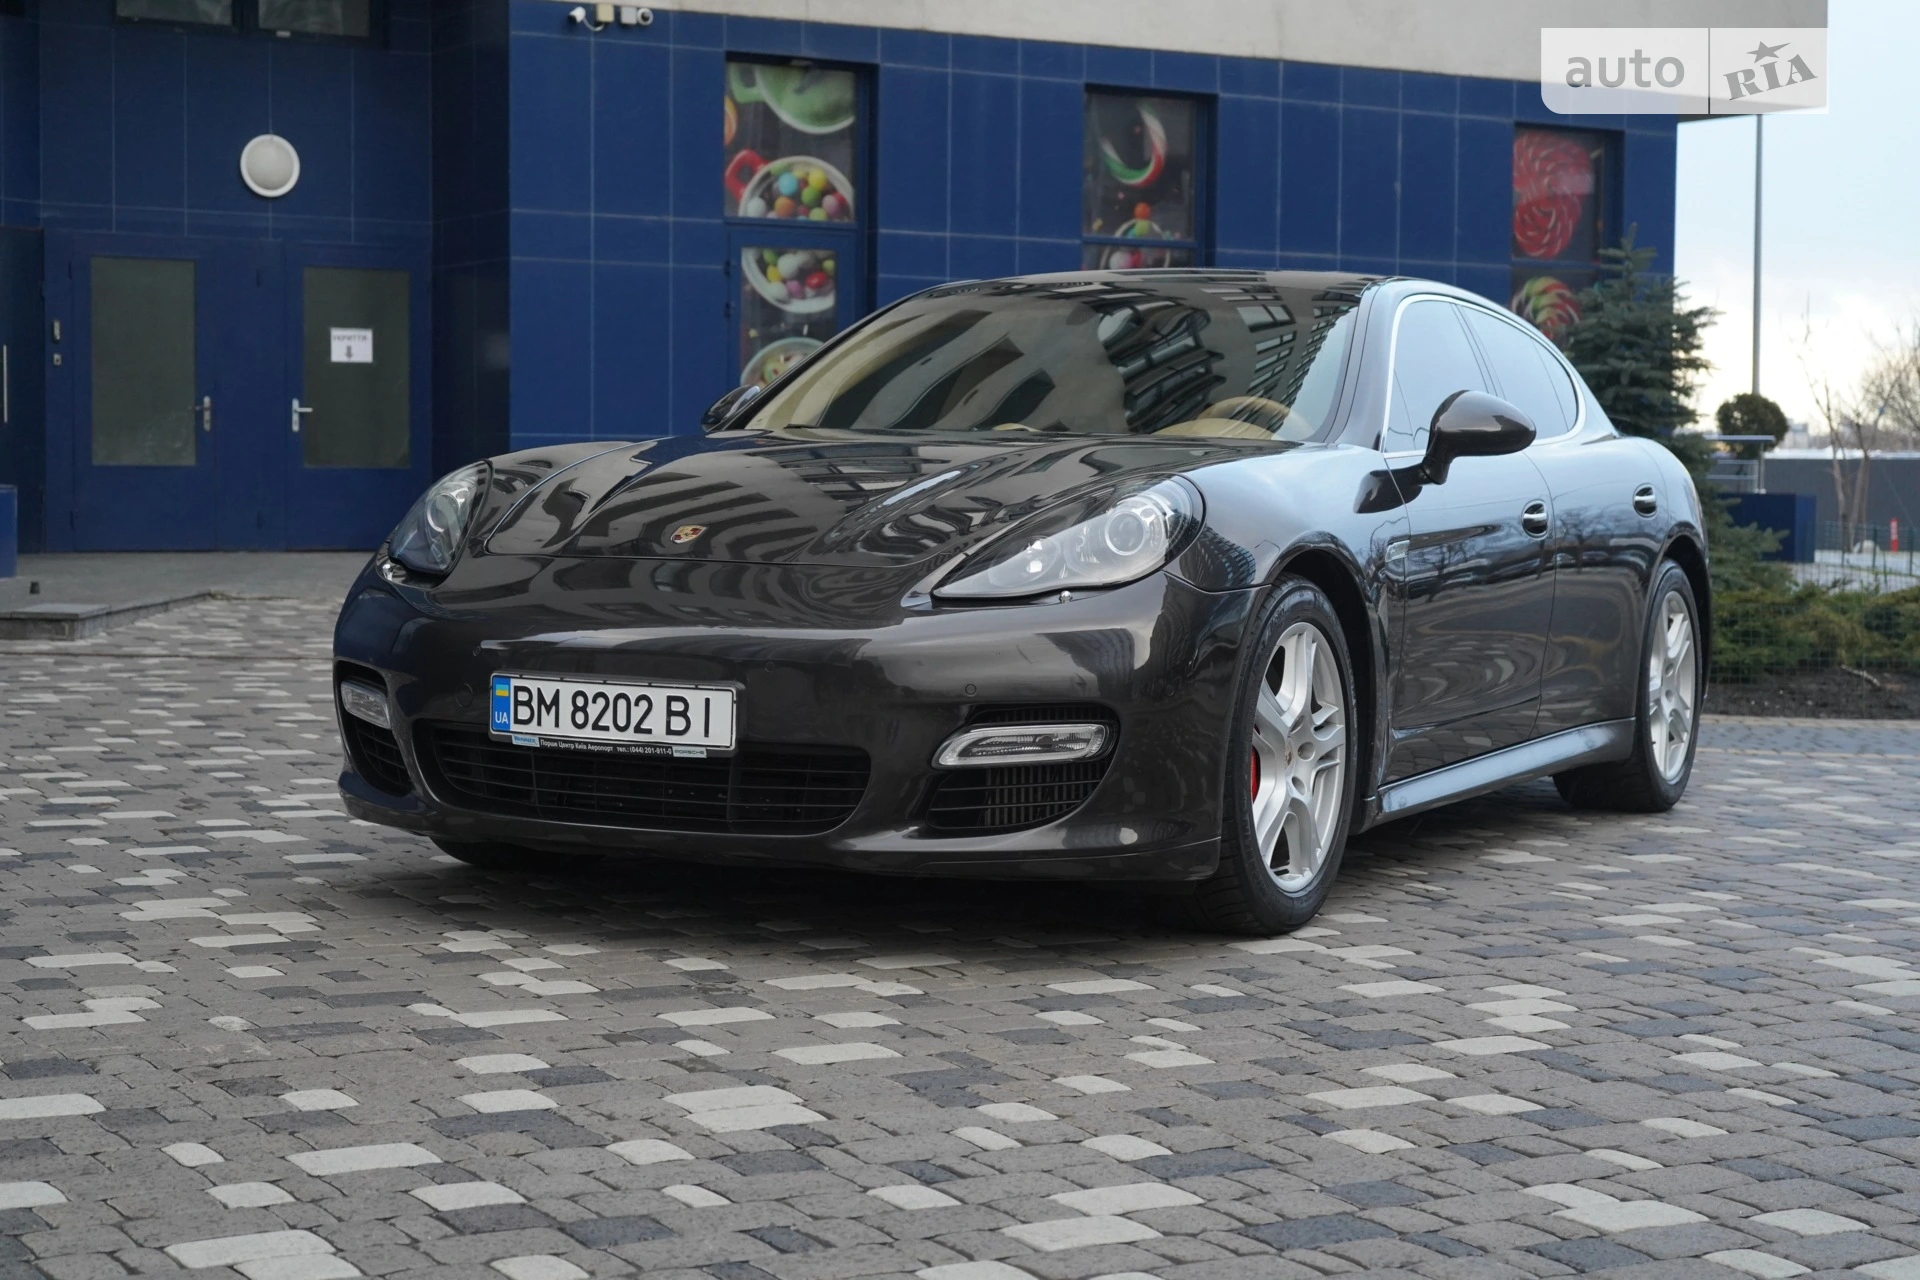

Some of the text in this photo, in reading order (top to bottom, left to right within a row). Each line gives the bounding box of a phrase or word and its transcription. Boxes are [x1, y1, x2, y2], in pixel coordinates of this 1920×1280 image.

[495, 712, 508, 724] UA
[513, 685, 561, 728] BM
[571, 690, 654, 734] 8202
